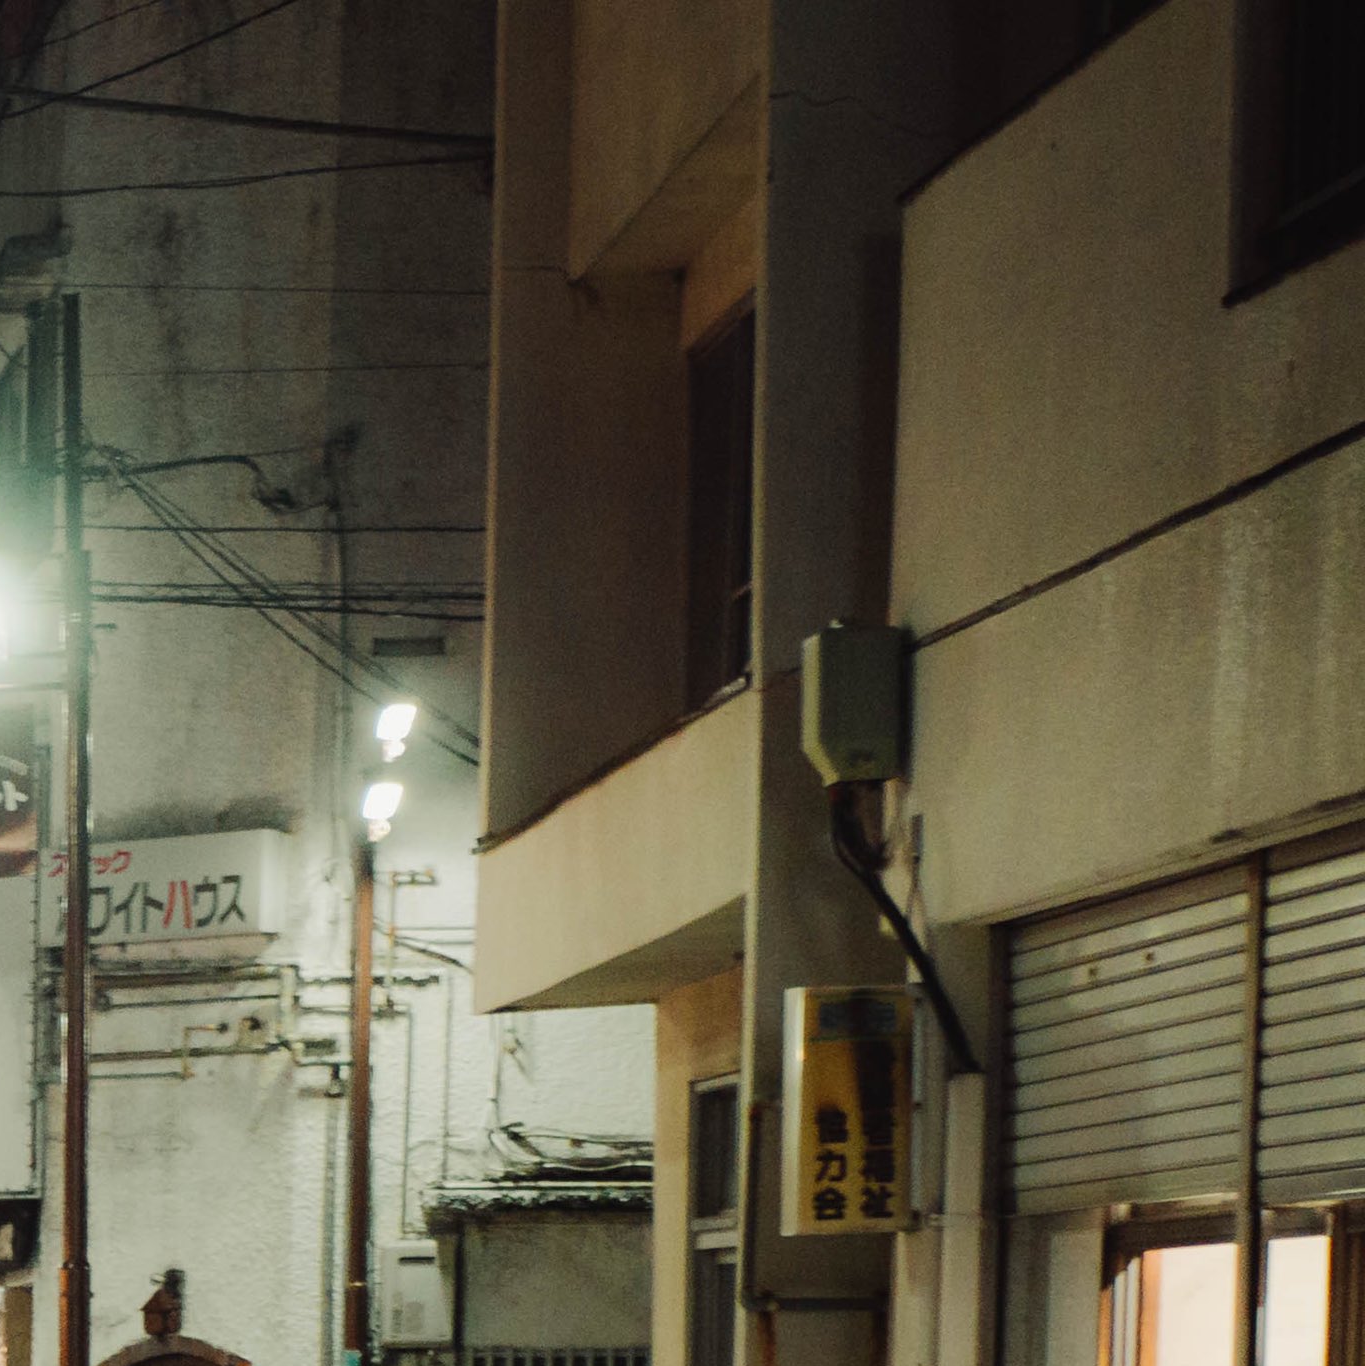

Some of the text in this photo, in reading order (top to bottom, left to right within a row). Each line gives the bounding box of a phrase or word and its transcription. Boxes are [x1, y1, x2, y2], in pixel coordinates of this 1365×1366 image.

[47, 850, 133, 878] スック
[54, 874, 246, 938] ワイトハウス
